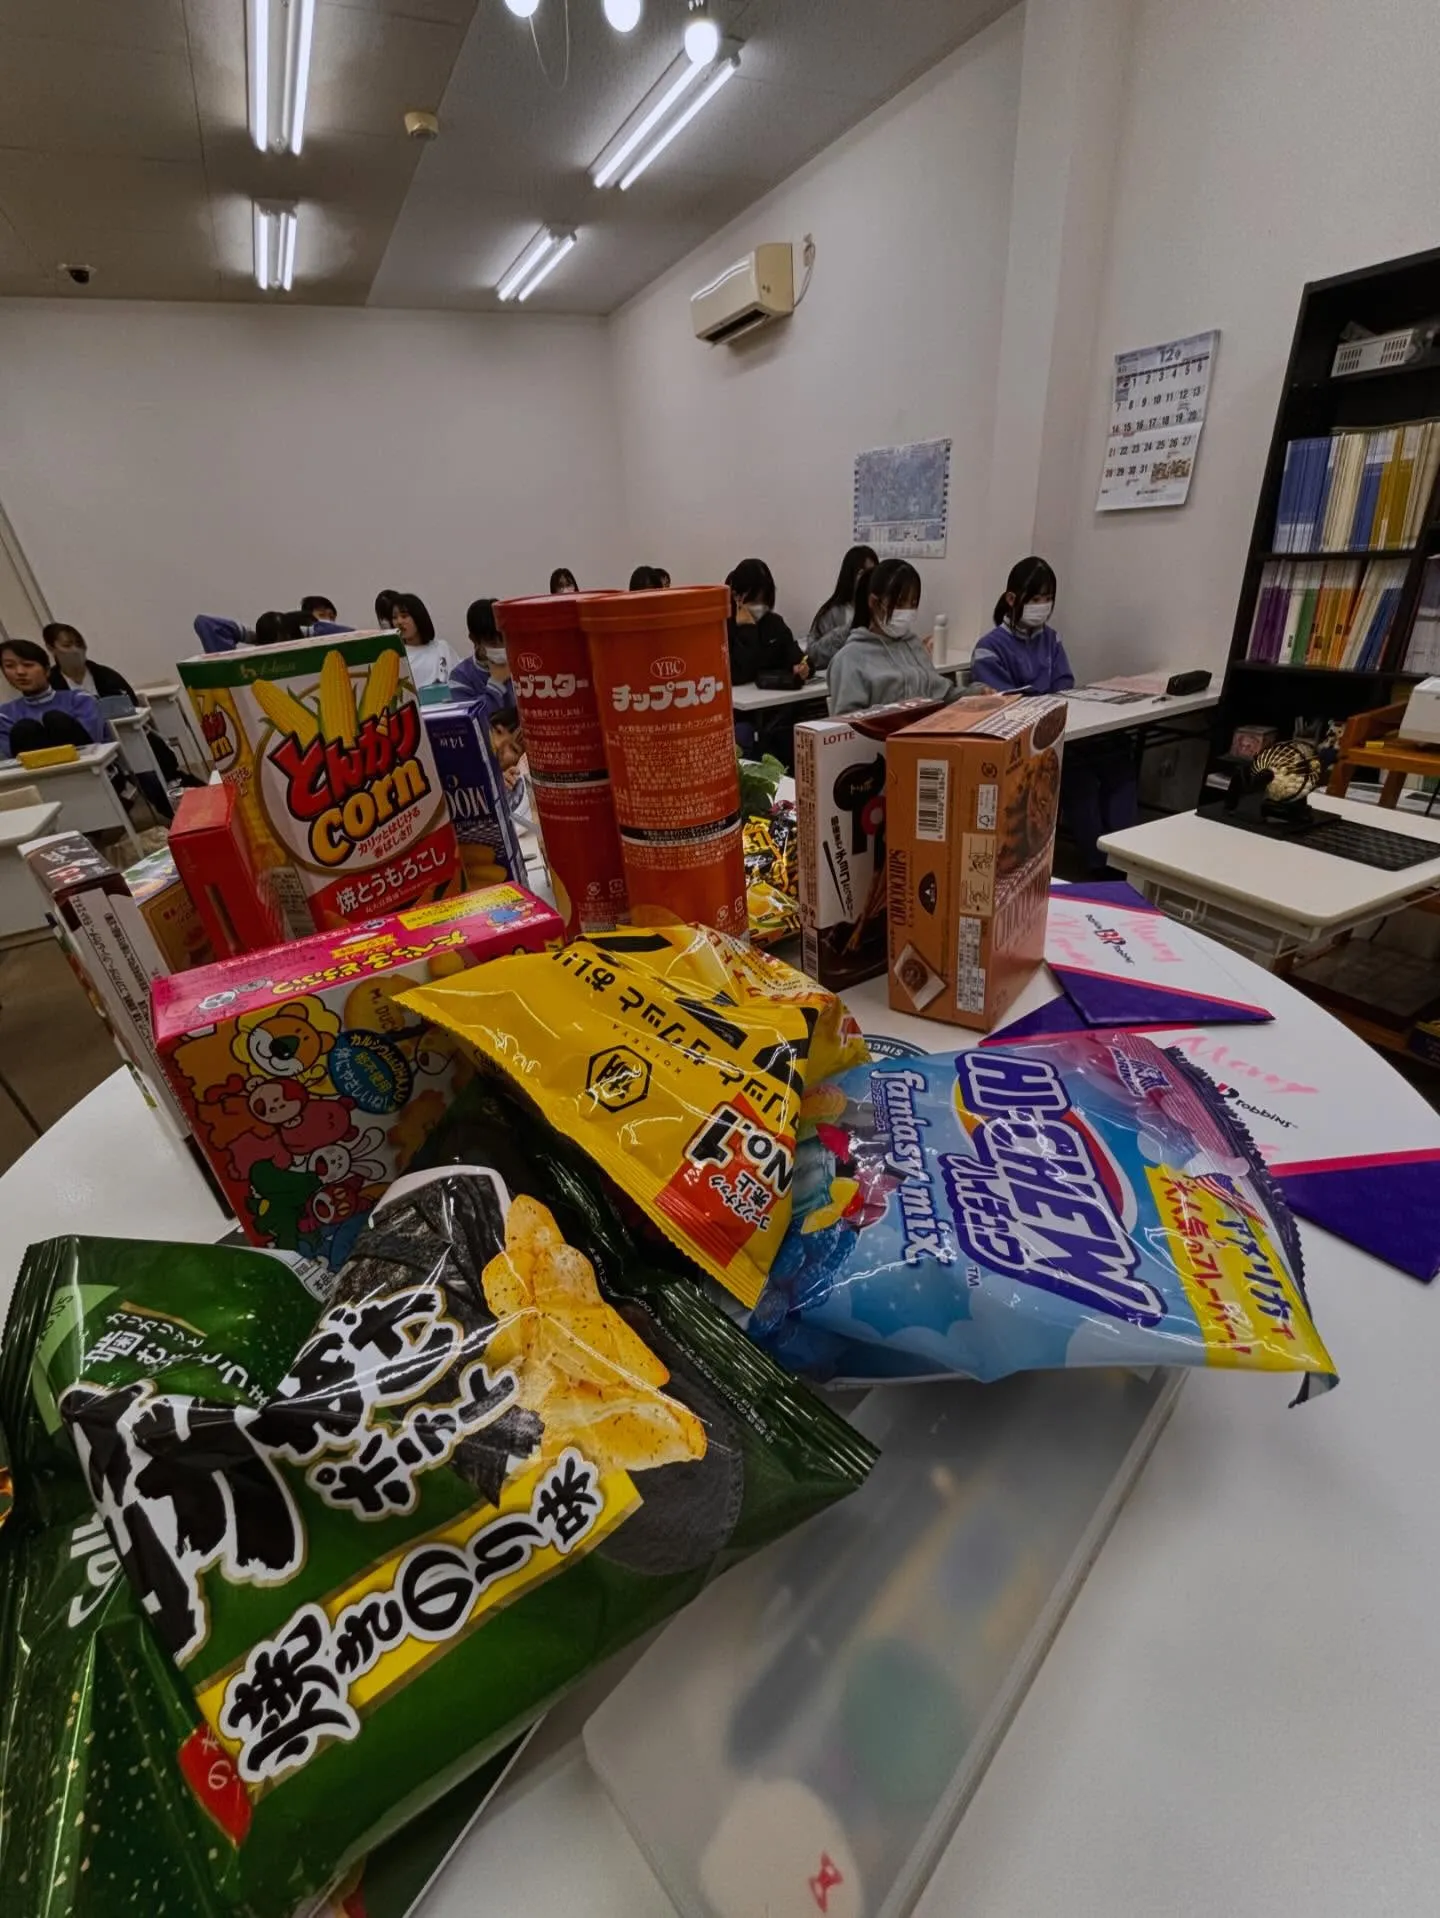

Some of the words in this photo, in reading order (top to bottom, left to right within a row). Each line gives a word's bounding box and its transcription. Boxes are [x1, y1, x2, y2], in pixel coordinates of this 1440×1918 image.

[521, 655, 539, 670] YBC
[654, 659, 683, 676] YBC
[612, 675, 724, 712] チップスター
[268, 702, 420, 818] とんがり
[823, 731, 856, 746] LOTTE
[312, 757, 430, 865] corn
[358, 807, 422, 857] カリッとはじける
[336, 846, 447, 915] 焼とうもろこし
[612, 1023, 682, 1076] KOIKEYA
[692, 1108, 794, 1193] No.1
[871, 1068, 929, 1186] fantasy
[903, 1182, 957, 1268] mix
[708, 1174, 771, 1232] コーンスナック
[735, 1171, 772, 1209] 売上
[106, 1312, 204, 1350] カリカリッと
[315, 1367, 514, 1514] ポテト
[227, 1455, 601, 1775] 焼きのり味
